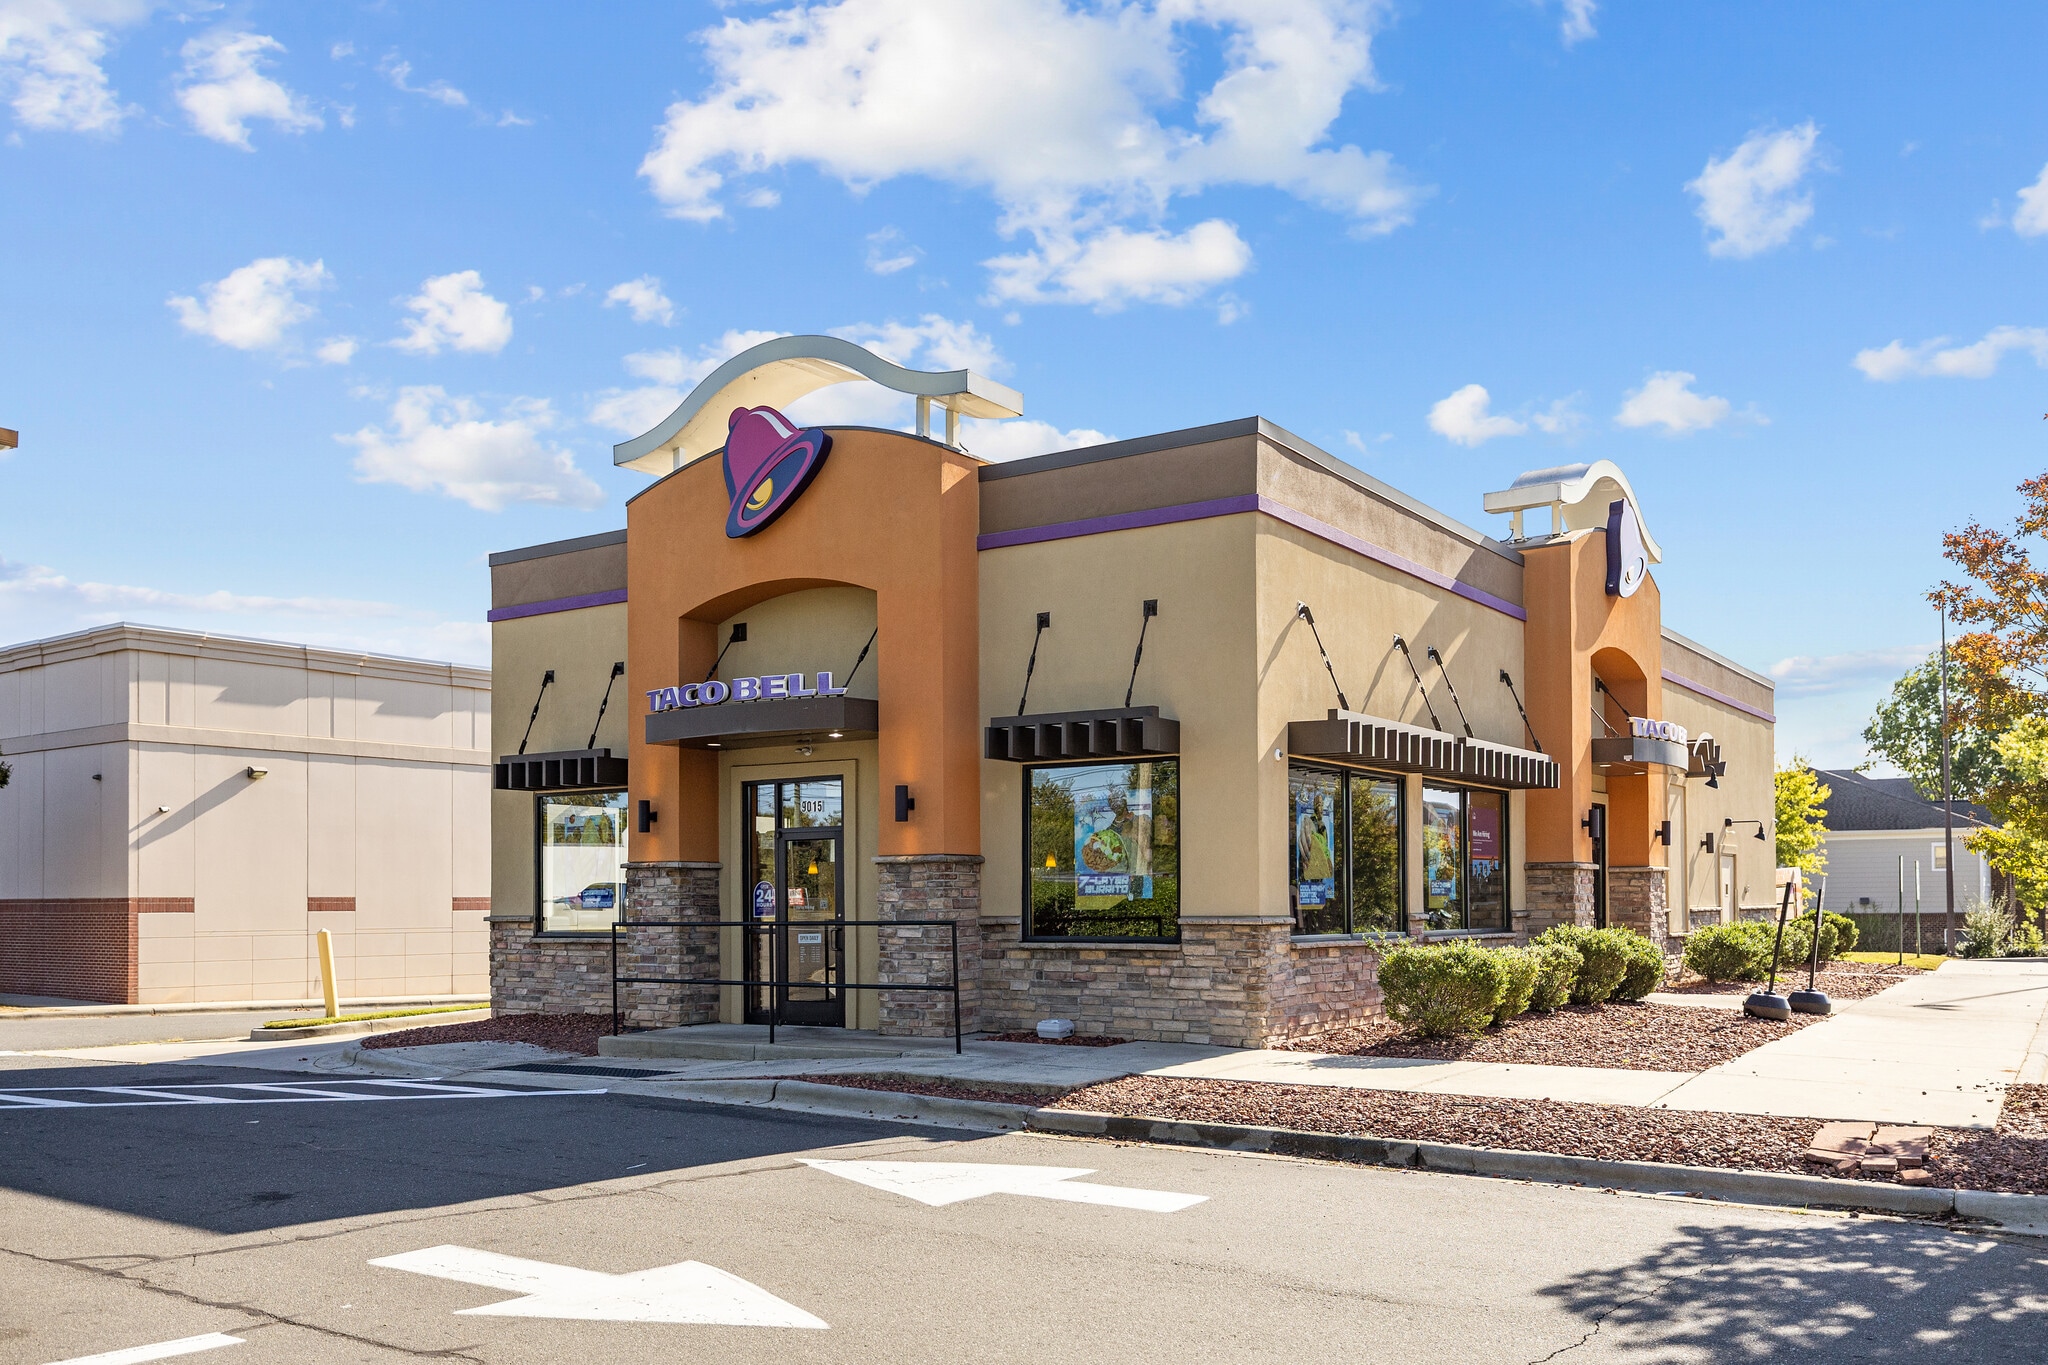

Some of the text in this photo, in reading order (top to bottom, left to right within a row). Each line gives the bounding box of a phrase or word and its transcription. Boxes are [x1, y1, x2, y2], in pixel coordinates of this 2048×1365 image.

[646, 671, 849, 712] TACO BELL
[1629, 717, 1677, 741] TACO
[801, 800, 822, 812] 9015
[1079, 876, 1129, 888] 7-LAYER
[756, 889, 773, 902] 24
[1085, 885, 1129, 894] BURRITO
